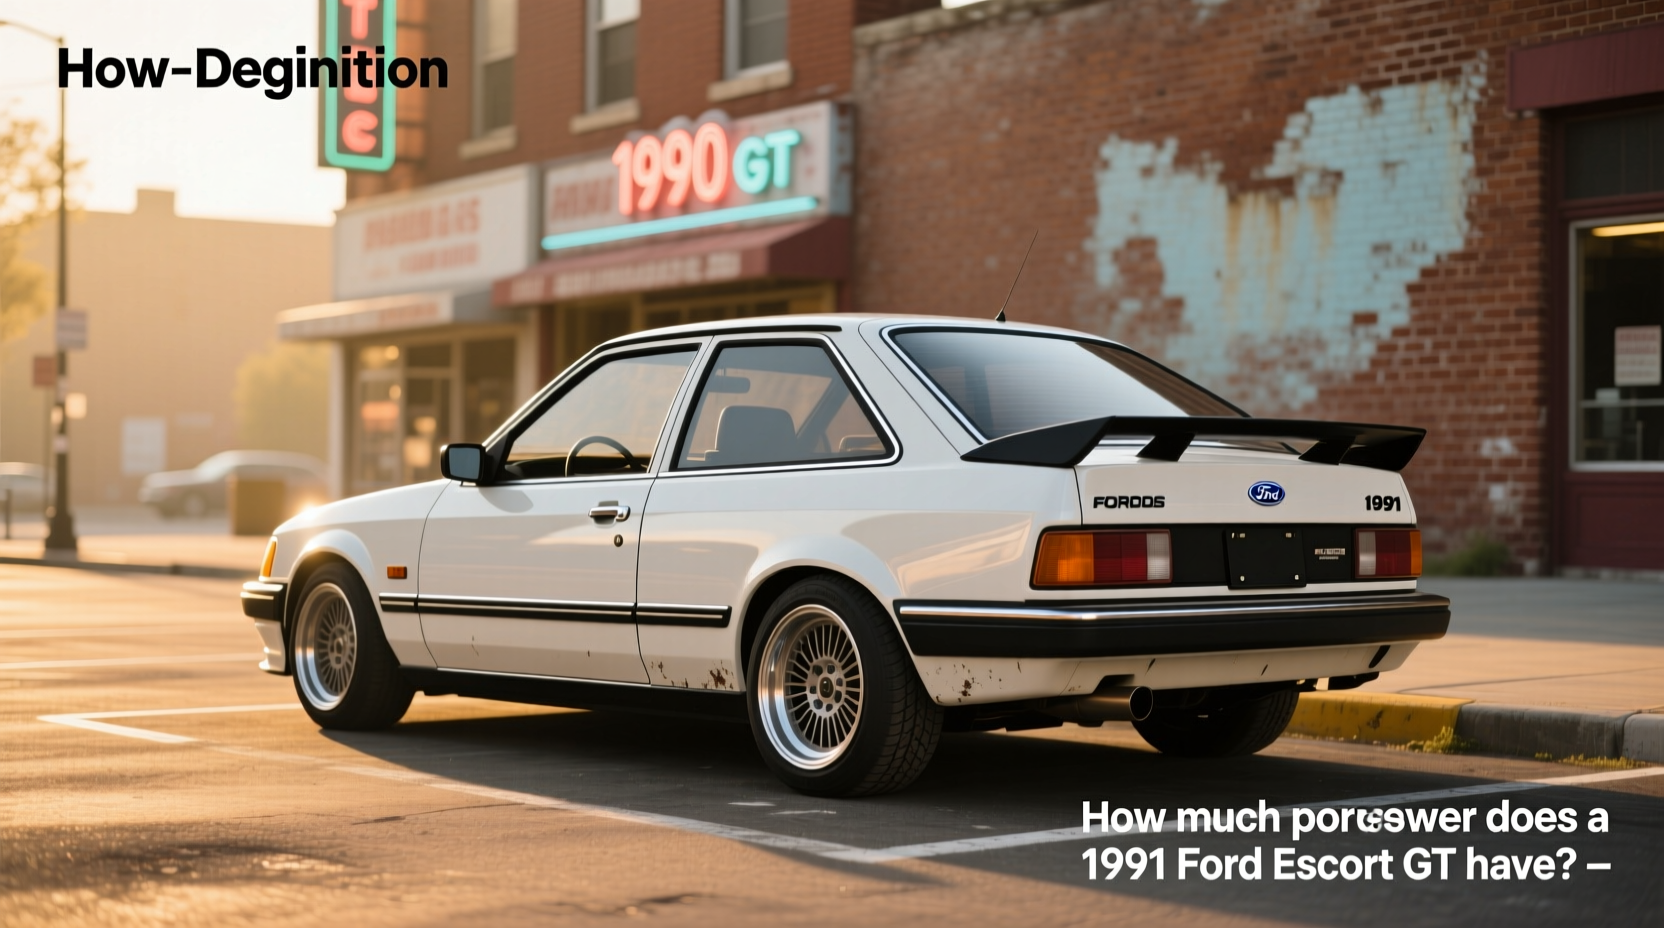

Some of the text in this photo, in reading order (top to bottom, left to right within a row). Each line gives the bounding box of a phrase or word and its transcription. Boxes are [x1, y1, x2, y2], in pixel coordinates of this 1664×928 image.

[611, 122, 729, 215] 1990
[732, 129, 801, 194] GT
[1364, 494, 1402, 512] 1991
